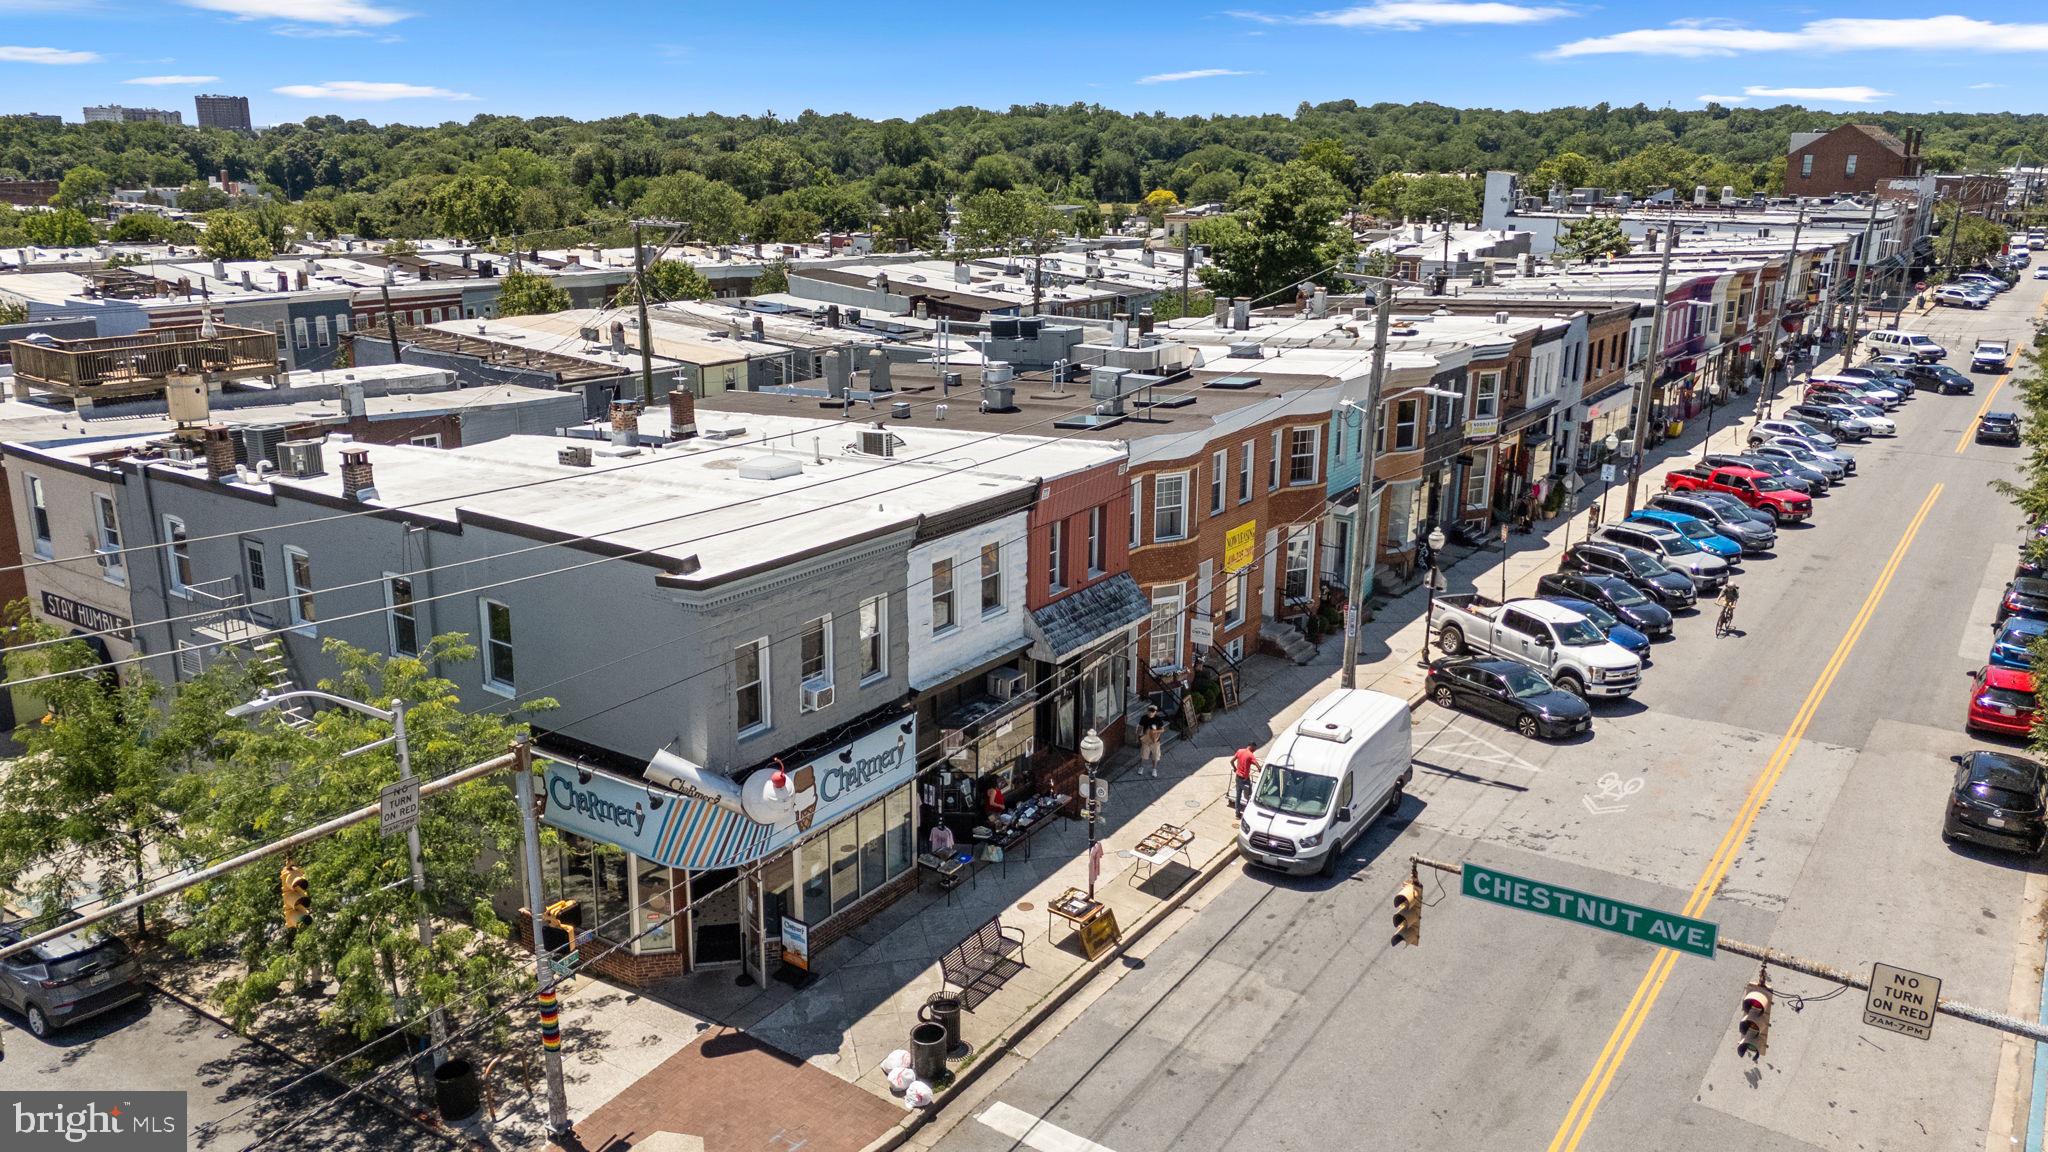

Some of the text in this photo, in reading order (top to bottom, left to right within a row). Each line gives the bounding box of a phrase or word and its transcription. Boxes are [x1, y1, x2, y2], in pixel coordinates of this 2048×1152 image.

[47, 595, 125, 638] STAY HUMBLE
[393, 785, 408, 796] NO
[390, 794, 412, 809] TURN
[384, 804, 416, 822] ON RED
[1473, 872, 1711, 949] CHESTNUT AVE.
[1894, 974, 1920, 989] NO
[1884, 986, 1924, 1006] TURN
[1873, 998, 1929, 1021] ON RED
[1869, 1015, 1923, 1036] 7AM-7PM
